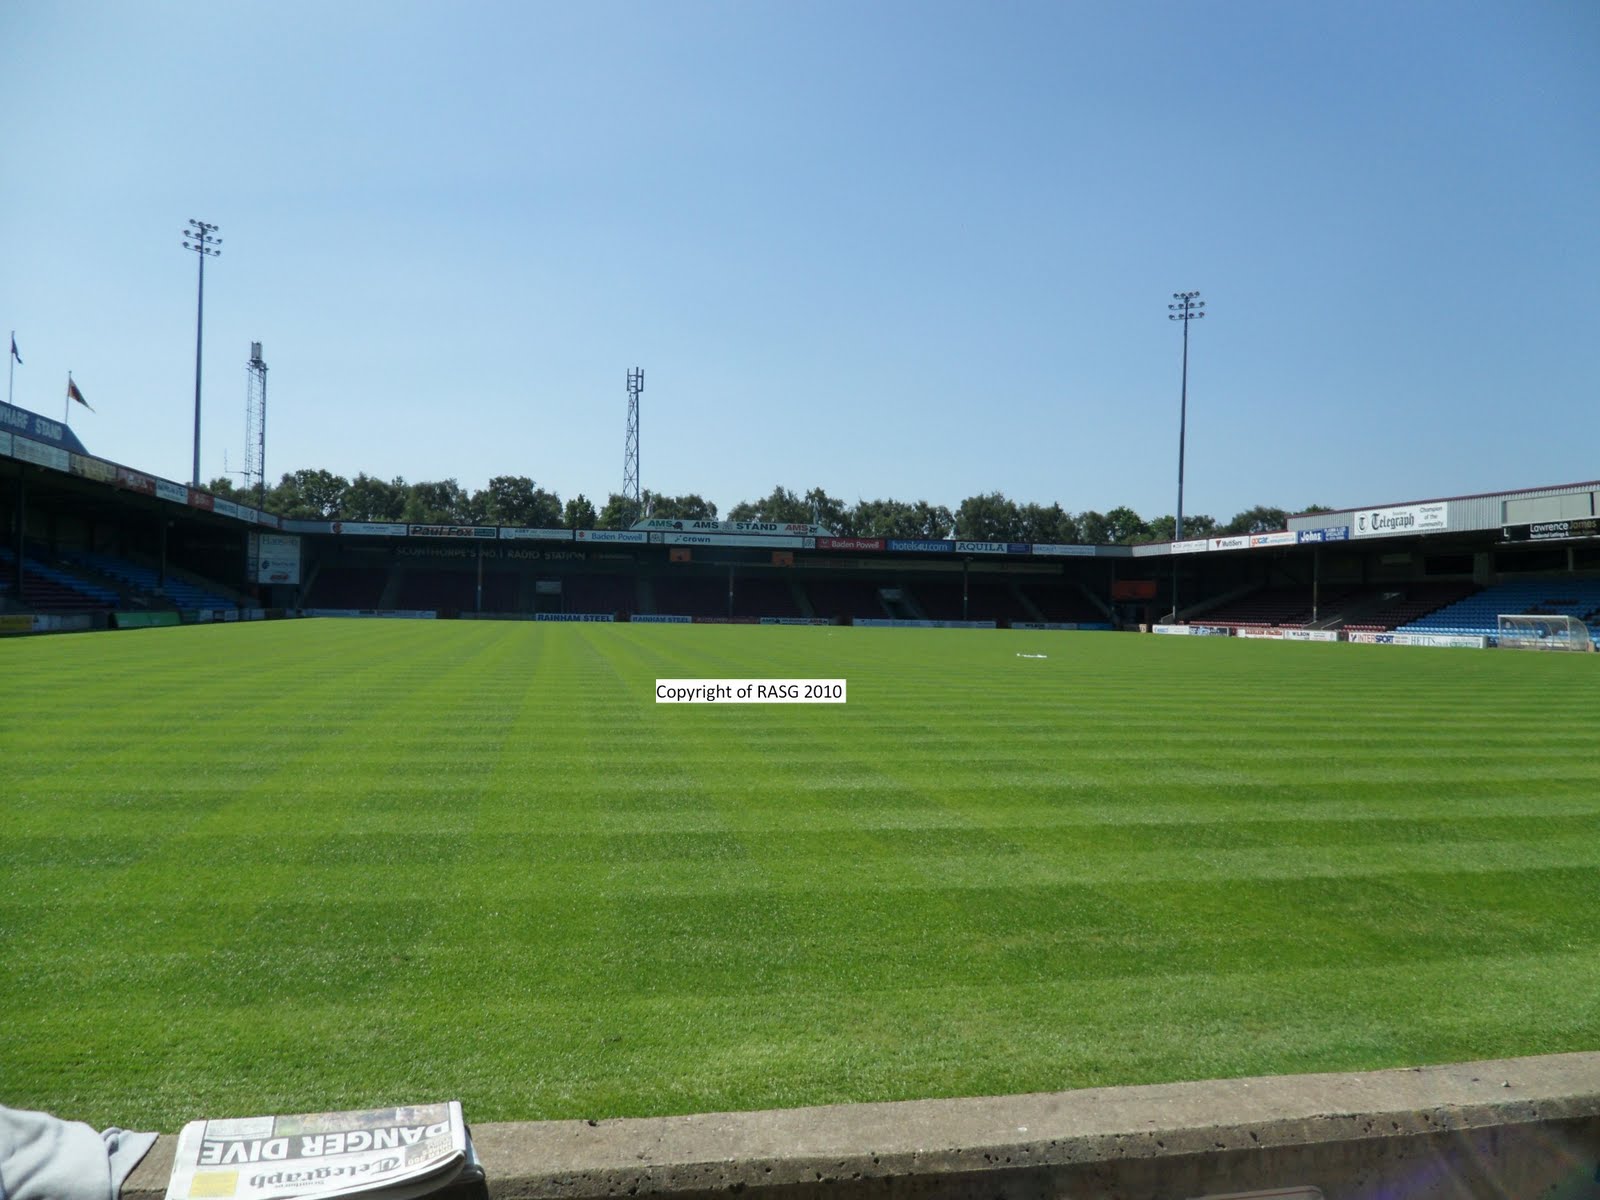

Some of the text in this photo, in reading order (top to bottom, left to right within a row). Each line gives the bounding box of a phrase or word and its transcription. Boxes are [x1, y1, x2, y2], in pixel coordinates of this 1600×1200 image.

[692, 521, 777, 531] AMS STAND
[1371, 513, 1415, 531] Telegraph
[1530, 522, 1568, 532] Lawrence
[411, 526, 443, 536] Paul
[447, 526, 474, 536] Fox
[591, 532, 643, 541] Baden Powell
[1301, 531, 1321, 542] Johns
[856, 541, 879, 549] Powell
[957, 543, 1005, 552] AQUILA
[507, 549, 540, 560] RADIO
[538, 614, 612, 622] RAINHAM STEEL
[300, 1121, 449, 1157] DANGER
[201, 1138, 289, 1165] DIVE
[249, 1157, 402, 1188] Telegraph
